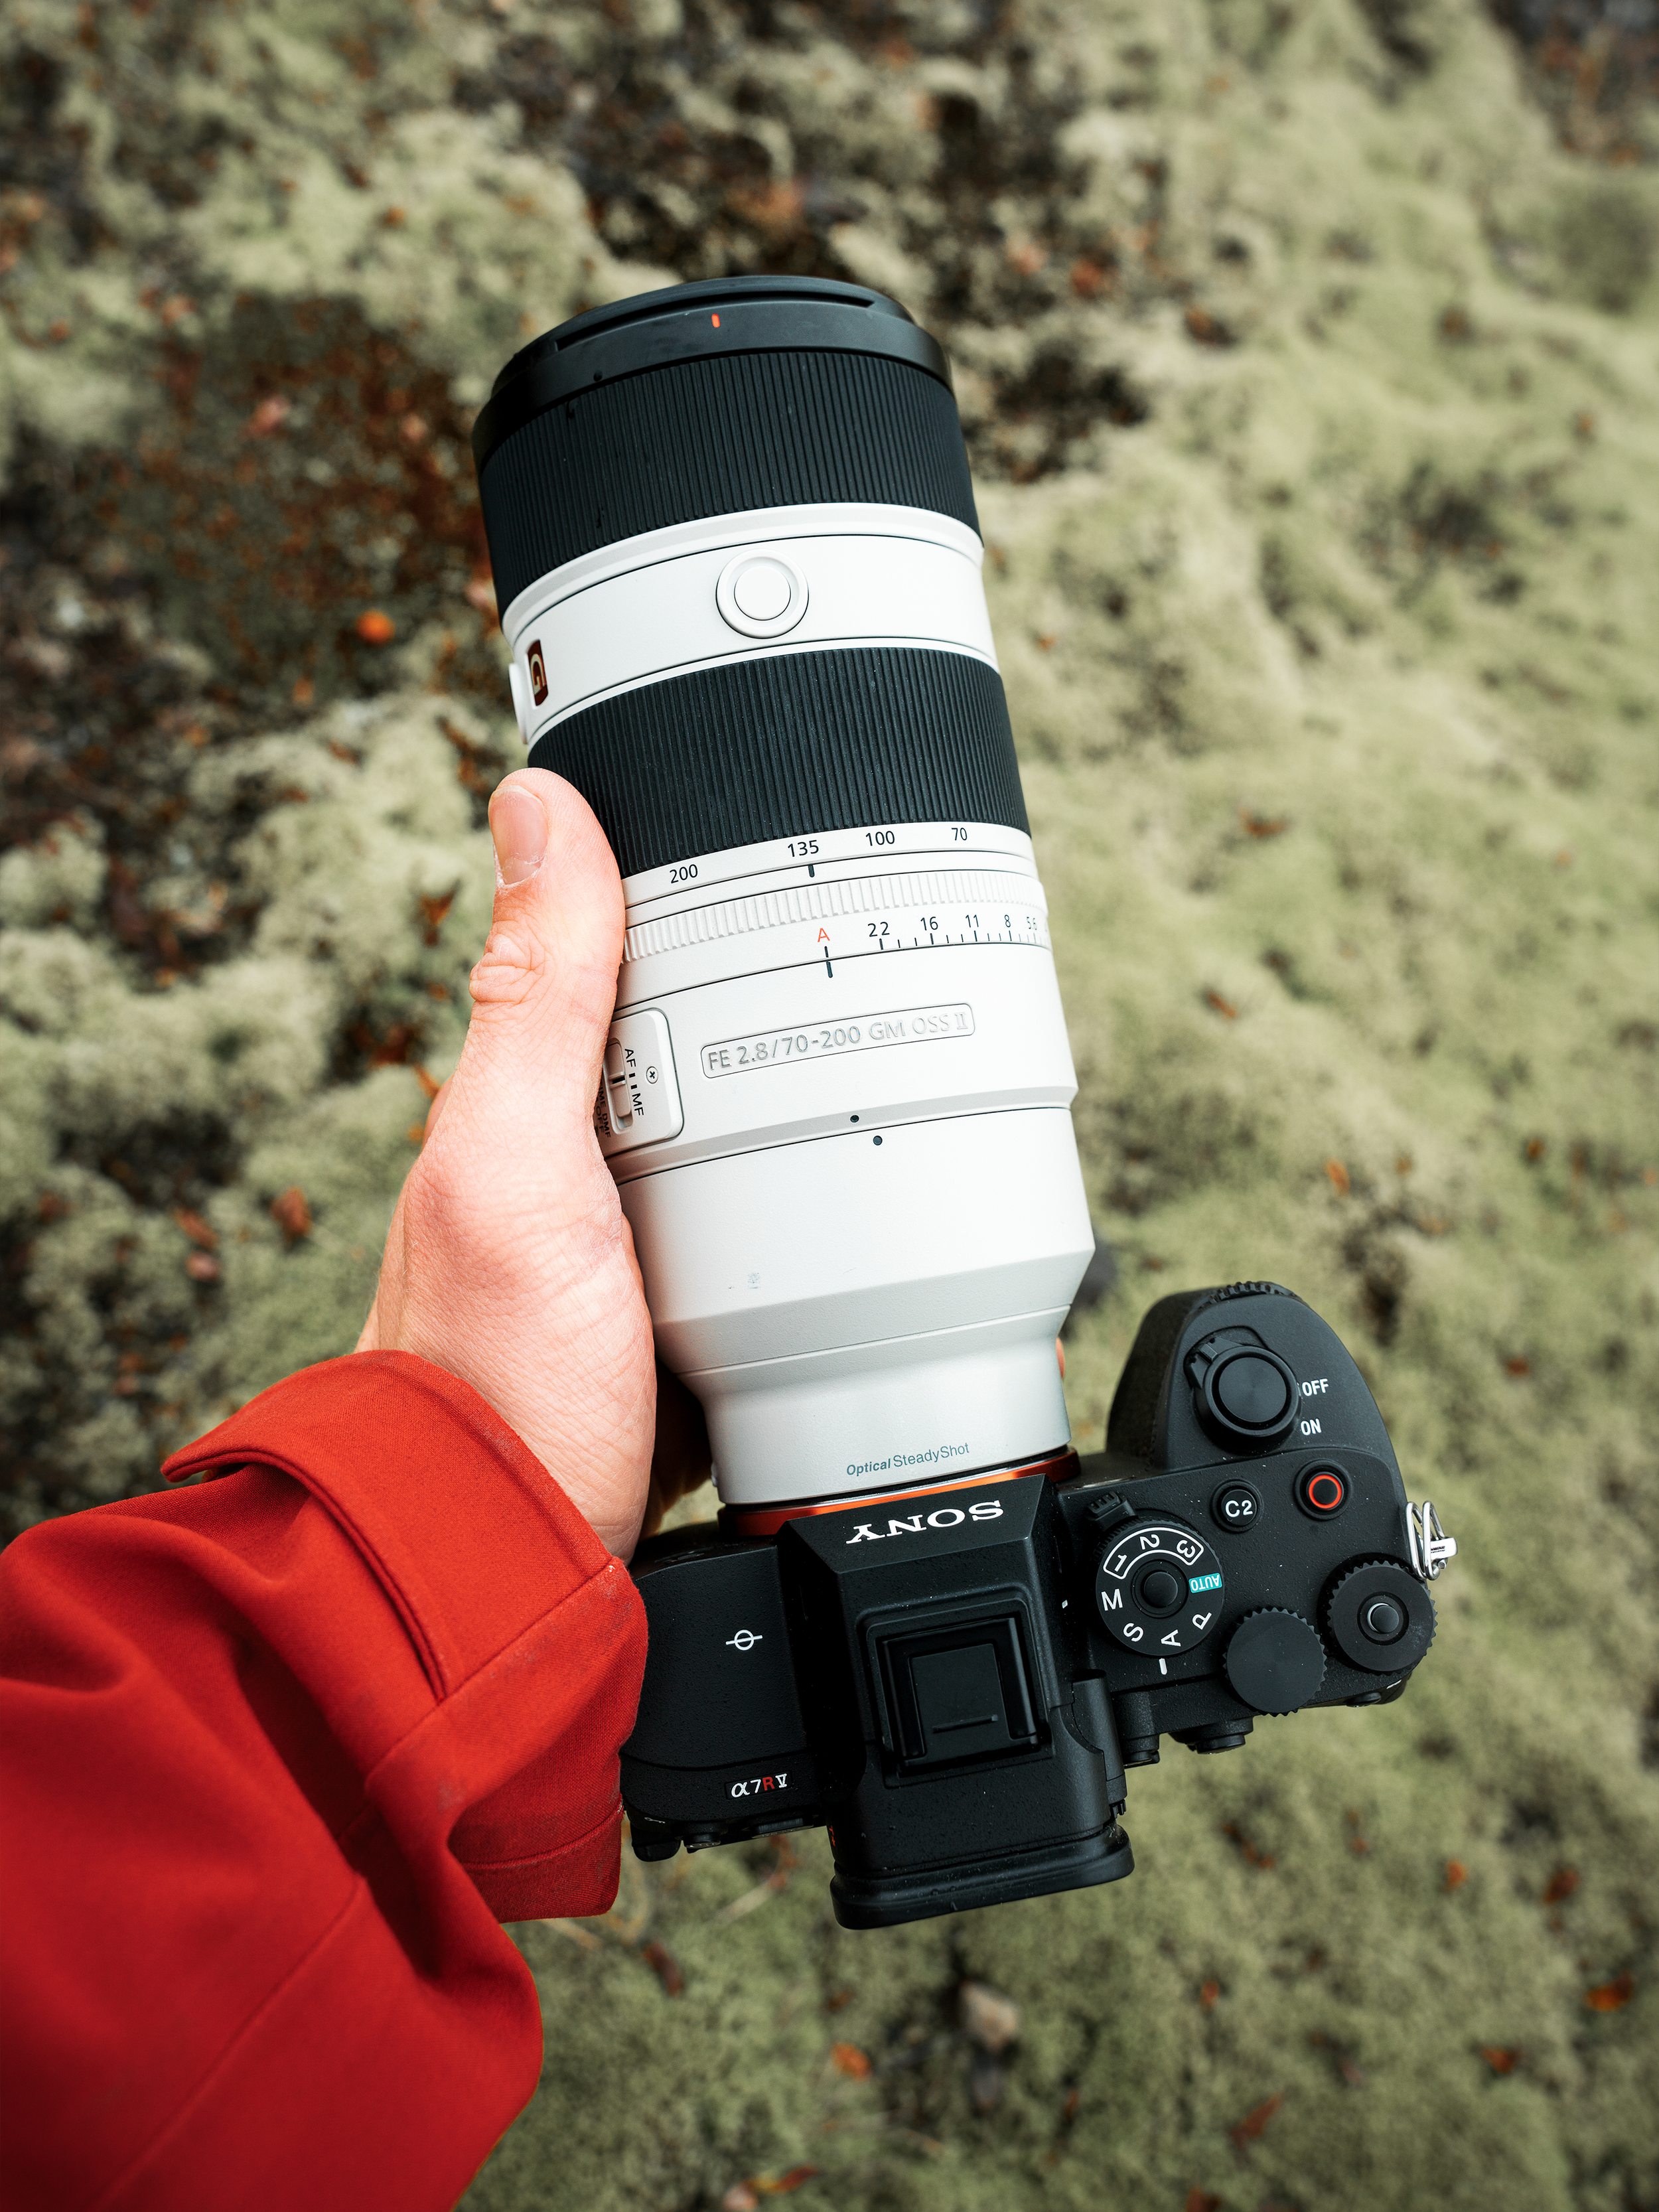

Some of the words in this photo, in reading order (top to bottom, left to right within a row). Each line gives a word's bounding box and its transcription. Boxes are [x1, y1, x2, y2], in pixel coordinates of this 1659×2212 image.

[865, 830, 895, 847] 100
[951, 827, 968, 841] 70
[787, 840, 819, 857] 135
[669, 863, 698, 884] 200
[867, 921, 890, 938] 22
[920, 916, 938, 931] 16
[965, 914, 979, 928] 11
[1004, 914, 1011, 928] 8
[817, 927, 830, 942] A
[707, 1049, 731, 1070] FE
[737, 1025, 861, 1065] 2.8/70-200
[869, 1019, 906, 1041] GM
[912, 1013, 951, 1034] OSS
[624, 1048, 636, 1067] AF
[632, 1092, 644, 1116] MF
[596, 1106, 605, 1133] OFF
[602, 1113, 611, 1138] DMF
[1301, 1378, 1329, 1396] OFF
[1300, 1418, 1322, 1436] ON
[846, 1458, 891, 1477] Optical
[893, 1443, 970, 1468] SteadyShot
[1225, 1499, 1254, 1518] C2
[845, 1499, 1004, 1544] SONY
[1139, 1534, 1160, 1550] 2
[1176, 1539, 1196, 1558] 3
[1114, 1554, 1127, 1572] 1
[1190, 1574, 1220, 1591] AUTO
[1101, 1588, 1123, 1611] M
[1192, 1612, 1212, 1630] P
[1123, 1623, 1144, 1642] S
[1161, 1629, 1181, 1647] A
